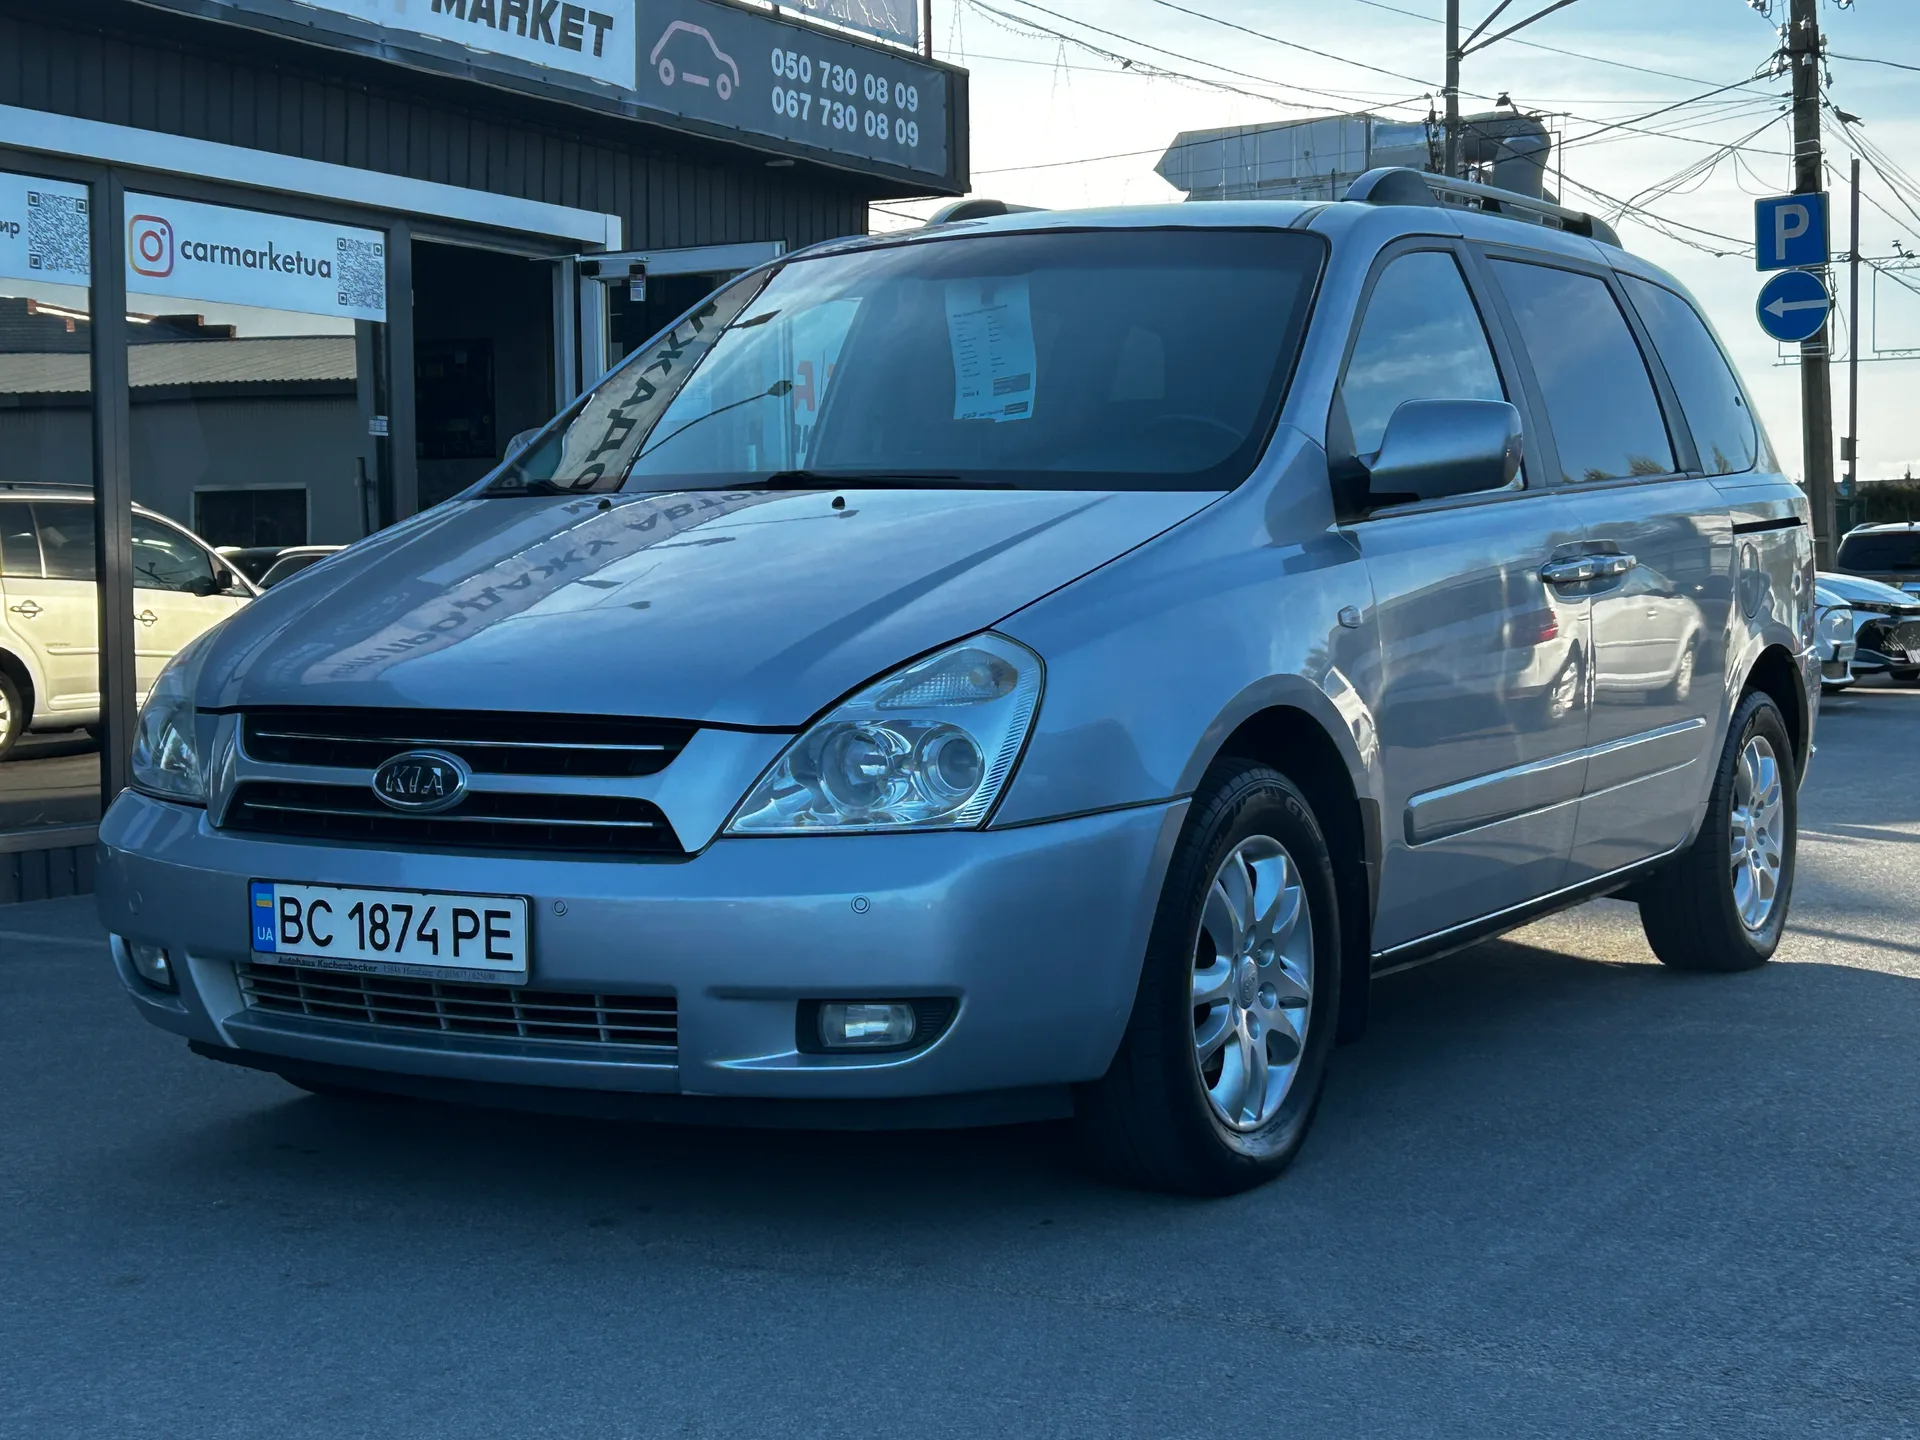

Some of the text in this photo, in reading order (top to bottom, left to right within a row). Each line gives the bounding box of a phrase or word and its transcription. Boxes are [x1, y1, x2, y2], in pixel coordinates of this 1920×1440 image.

[771, 47, 918, 112] 050 730 08 09
[771, 86, 919, 147] 067 730 08 09
[180, 238, 332, 279] carmarketua
[1775, 203, 1810, 260] P
[385, 765, 444, 795] KIA
[257, 926, 274, 942] UA
[279, 896, 514, 961] BC 1874 PE
